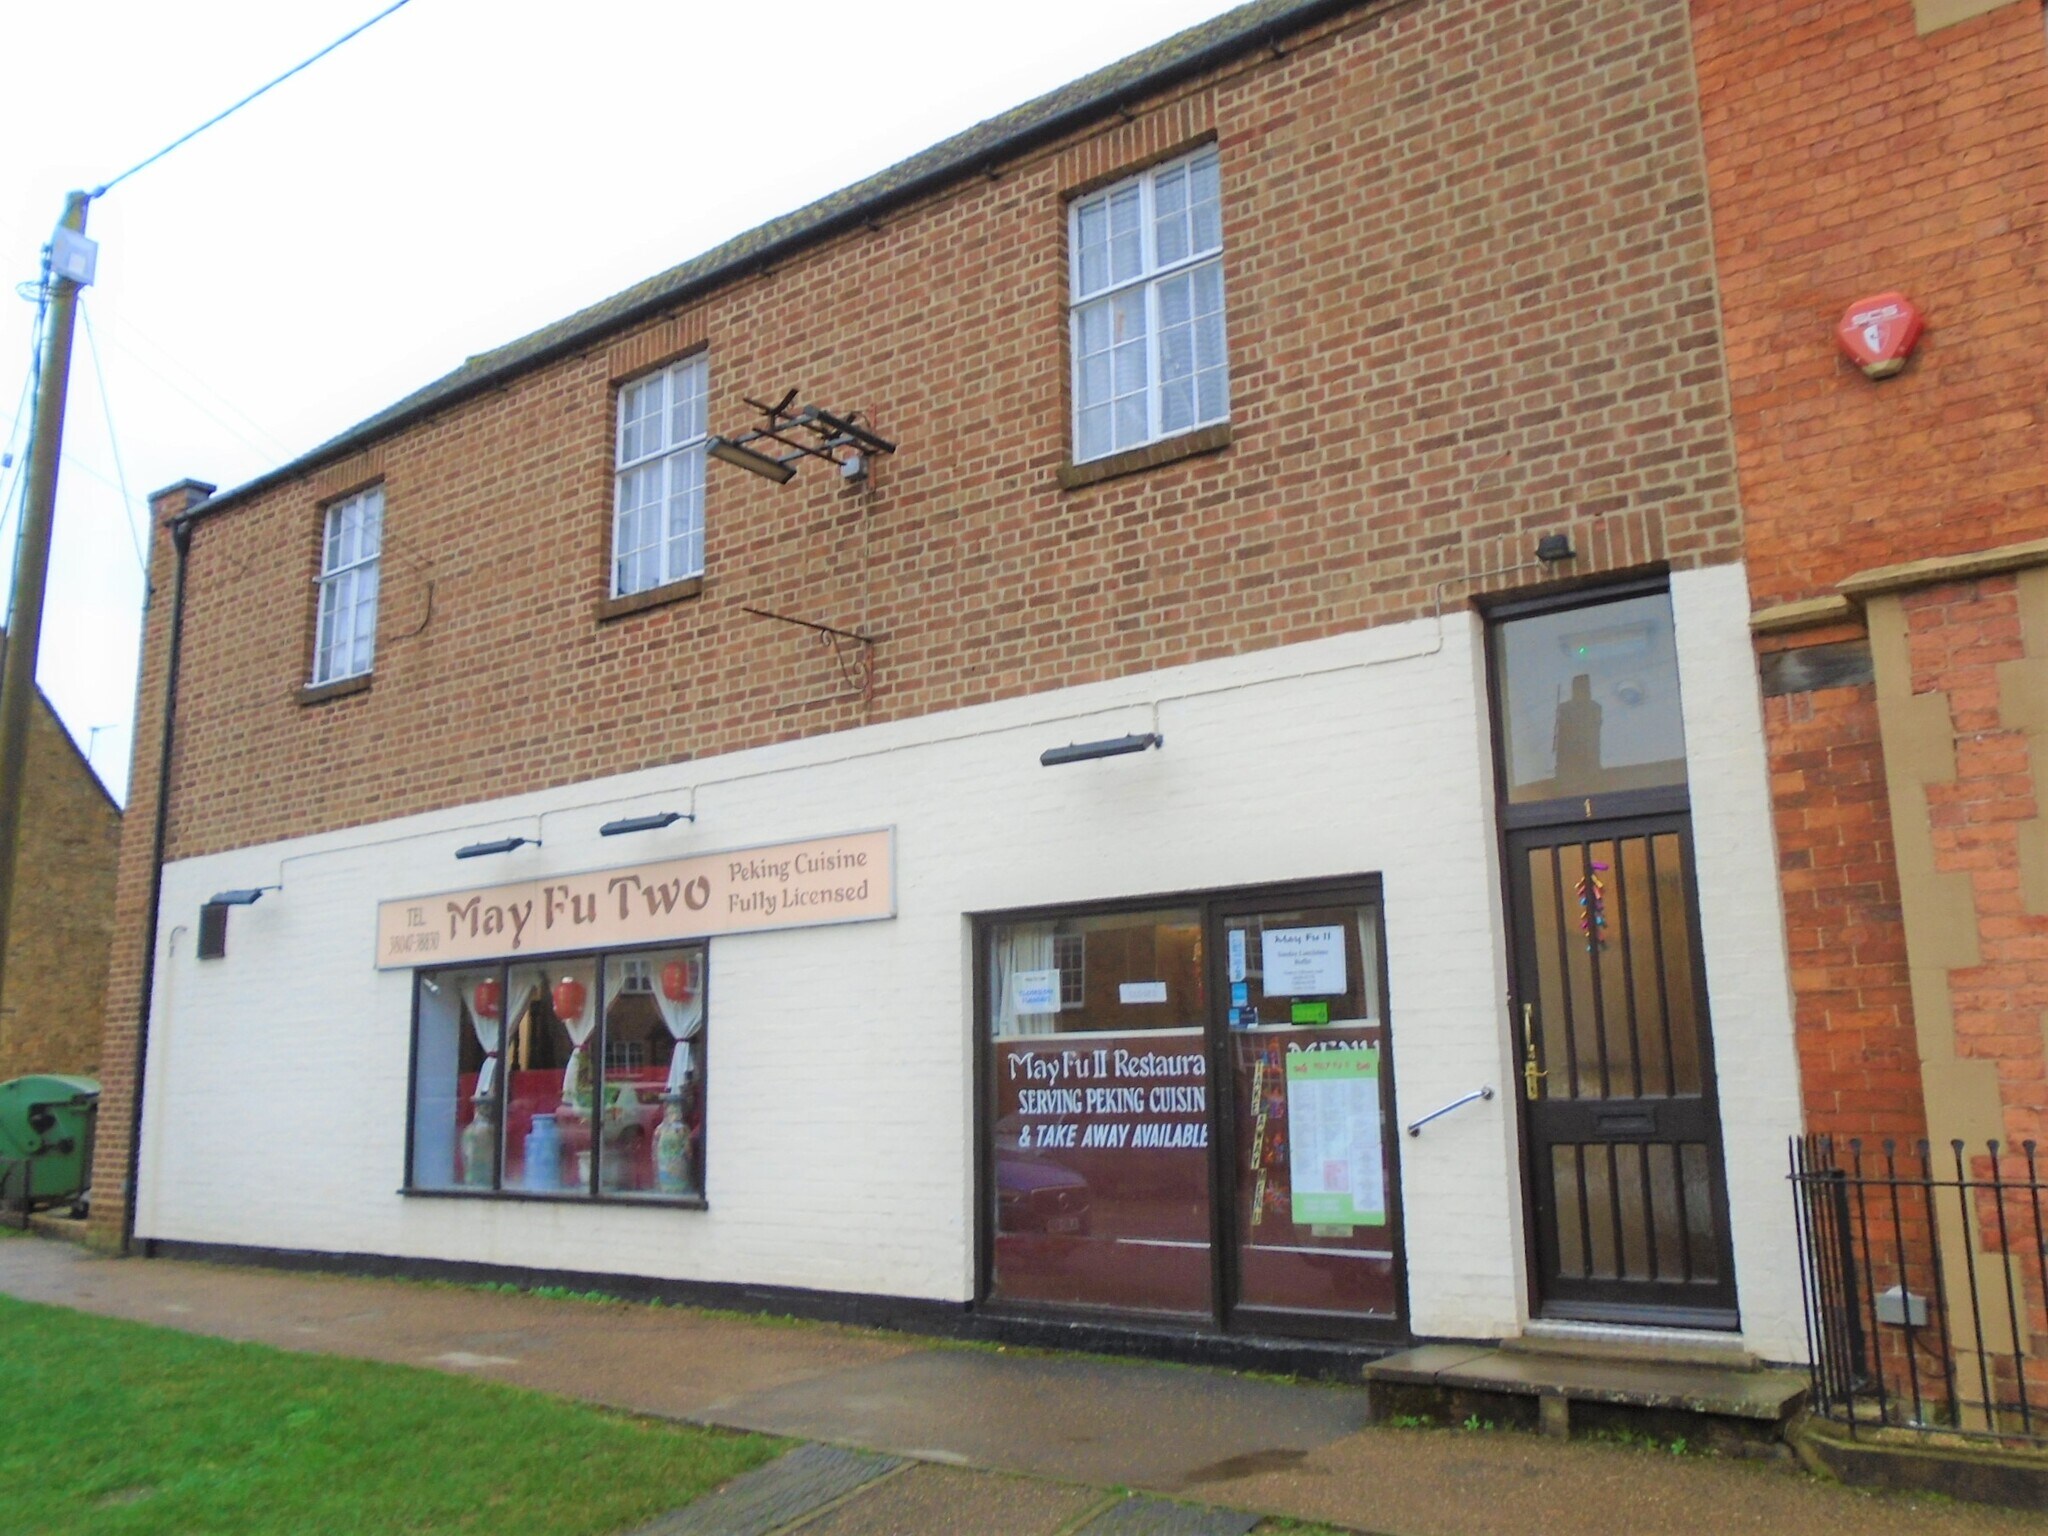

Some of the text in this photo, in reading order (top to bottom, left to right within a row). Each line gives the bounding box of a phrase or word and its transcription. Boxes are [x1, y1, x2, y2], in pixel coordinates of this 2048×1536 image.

[728, 849, 867, 882] Peking Cuisine
[447, 874, 711, 949] May Fu Two
[728, 879, 869, 916] Fully Licensed
[406, 906, 426, 927] TEL
[1305, 932, 1320, 942] Fu
[1007, 1051, 1060, 1087] May
[1062, 1050, 1089, 1079] Fu
[1113, 1048, 1206, 1078] Restaura
[1018, 1085, 1206, 1115] SERVING PEKING CUISIN
[1018, 1122, 1208, 1148] & TAKE AWAY AVAILABLE
